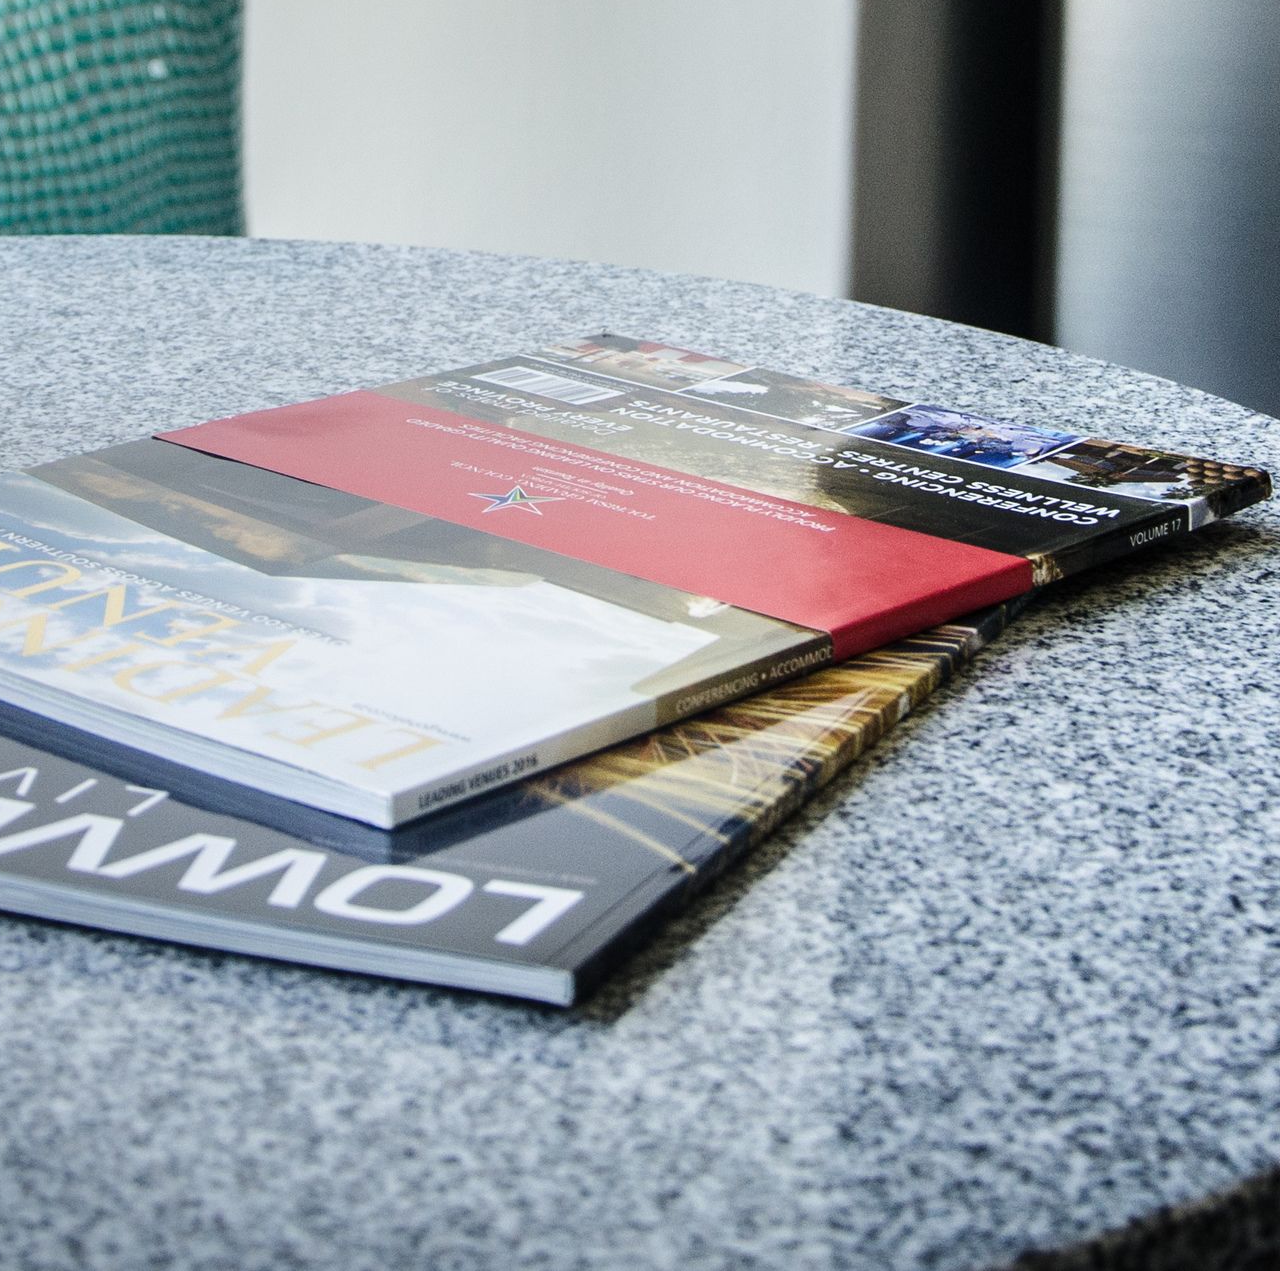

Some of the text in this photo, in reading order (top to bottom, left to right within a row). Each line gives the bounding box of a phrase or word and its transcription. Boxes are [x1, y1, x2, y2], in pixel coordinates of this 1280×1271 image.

[437, 380, 634, 432] EVERY PROVINCE
[520, 408, 616, 436] Detailed
[609, 407, 1099, 525] CONFERENCING ACCOMMODATION
[629, 400, 1120, 518] WELLNESS CENTRES RESTAURANTS
[756, 507, 836, 532] PROUDLY
[1129, 518, 1182, 547] VOLUME 17
[2, 530, 96, 571] SOUTHERN
[99, 563, 177, 594] ACROSS
[177, 590, 249, 618] VENUES
[676, 671, 758, 715] CONFERENCING
[418, 778, 466, 809] LEADING
[467, 763, 510, 793] VENUES
